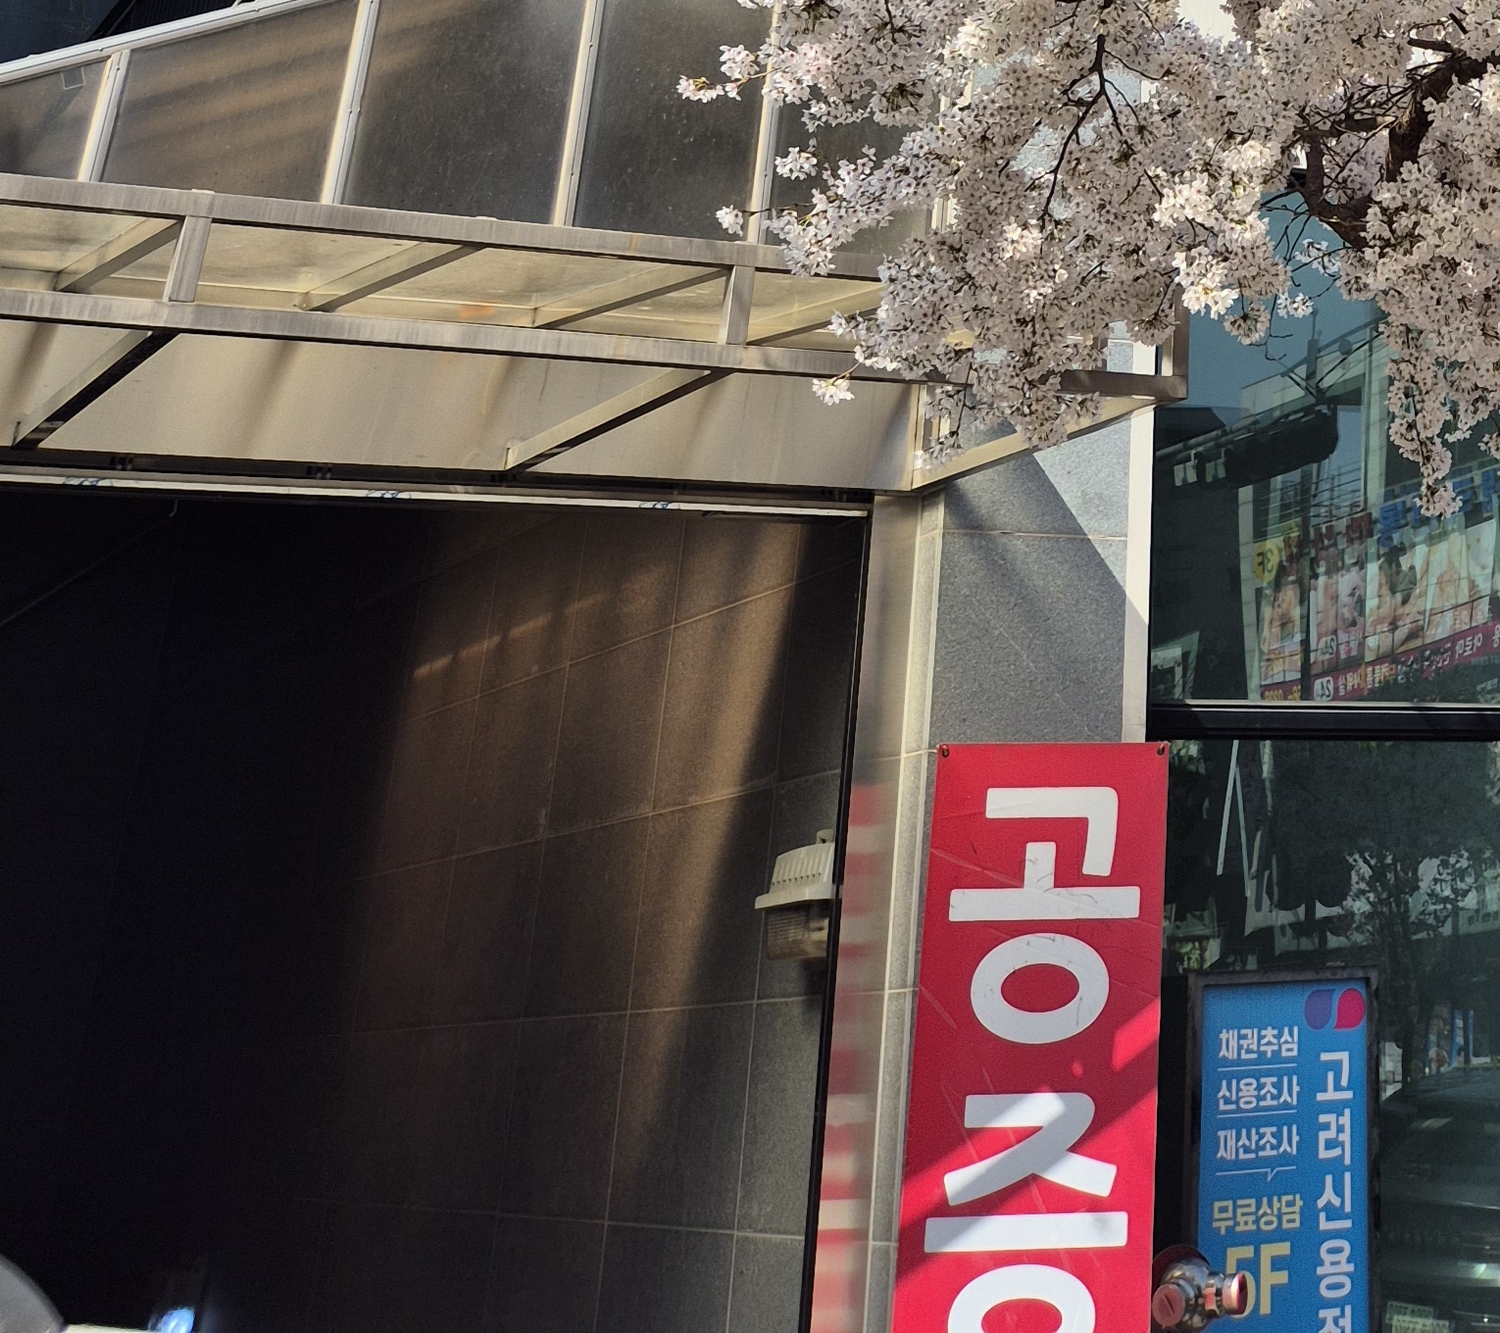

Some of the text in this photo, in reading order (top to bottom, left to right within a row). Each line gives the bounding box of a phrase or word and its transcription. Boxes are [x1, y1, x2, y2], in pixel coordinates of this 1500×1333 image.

[1218, 1025, 1300, 1061] 채권추심
[1217, 1075, 1300, 1112] 신용조사
[1216, 1124, 1300, 1161] 재산조사
[1212, 1193, 1304, 1236] 무료상담
